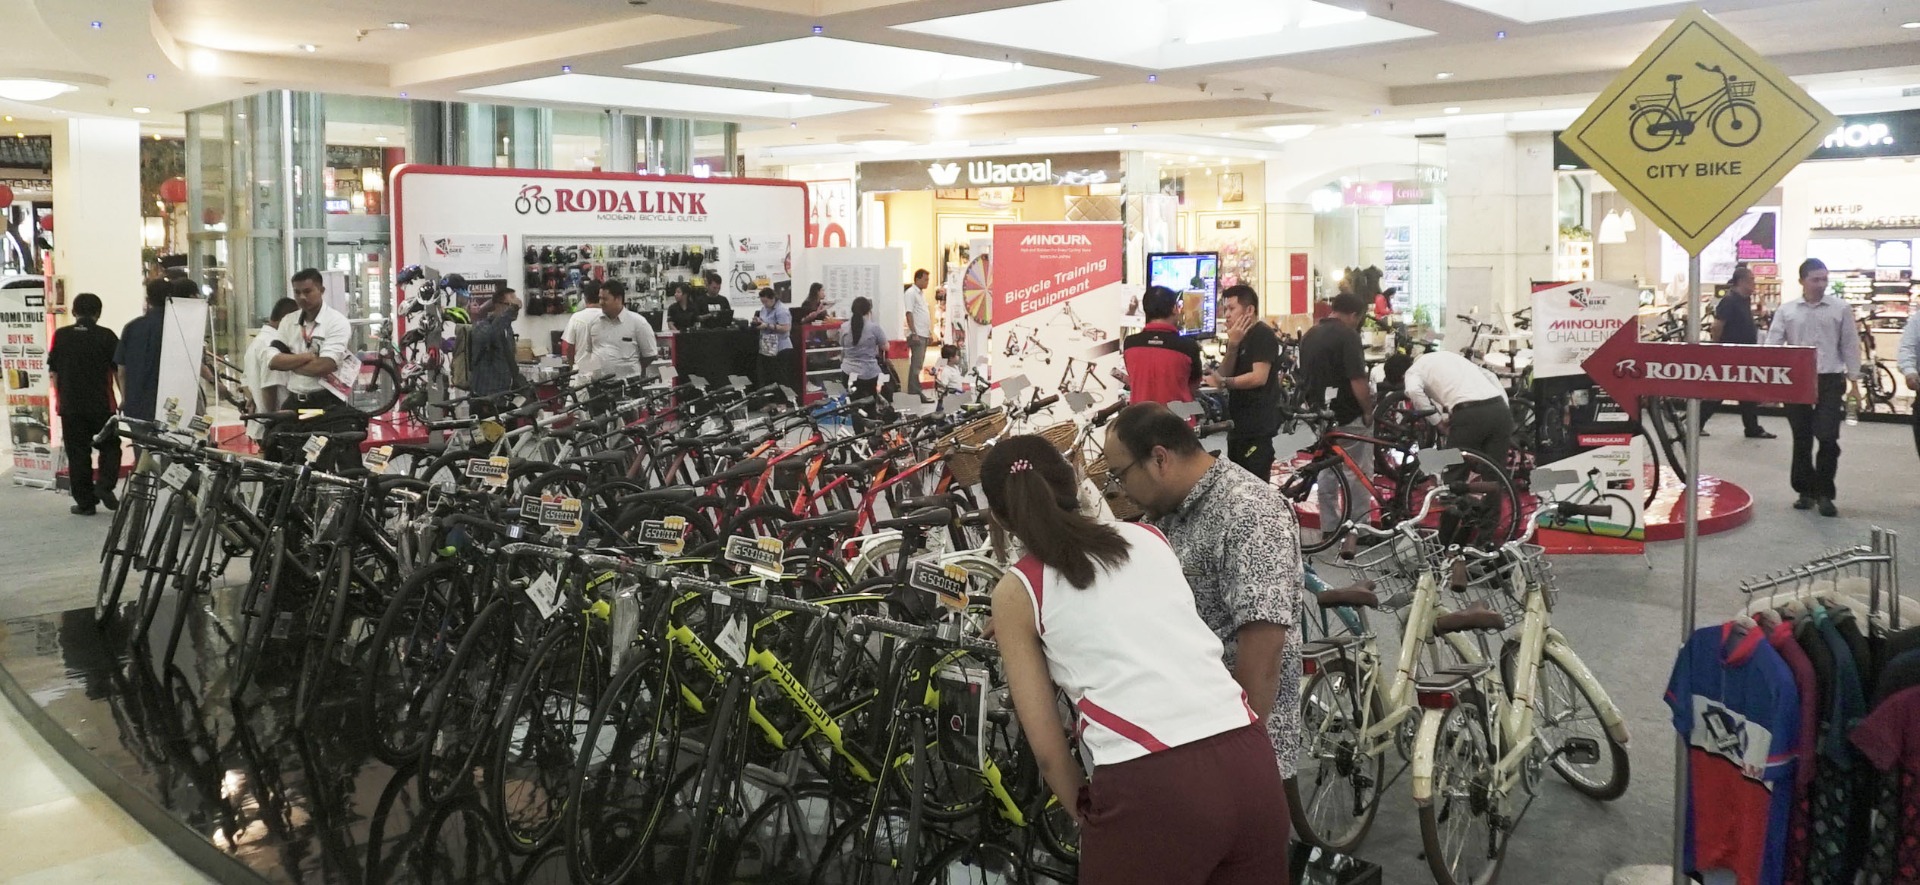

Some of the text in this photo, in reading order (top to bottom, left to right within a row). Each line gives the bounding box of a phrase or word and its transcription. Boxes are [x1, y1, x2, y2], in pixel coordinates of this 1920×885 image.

[1817, 123, 1893, 148] HOP.
[968, 159, 1051, 184] Wacoal
[1646, 161, 1742, 179] CITY BIKE
[555, 188, 708, 215] RODALINK
[1814, 204, 1863, 215] MAKE-UP
[639, 214, 674, 222] BICYCLE
[677, 215, 708, 223] OUTLET
[1020, 234, 1092, 246] MINOURA
[1005, 258, 1107, 304] Bicycle Training
[1020, 278, 1090, 313] Equipment
[22, 312, 44, 323] THULE
[1645, 362, 1793, 385] RODALINK
[772, 663, 833, 727] POLYGON
